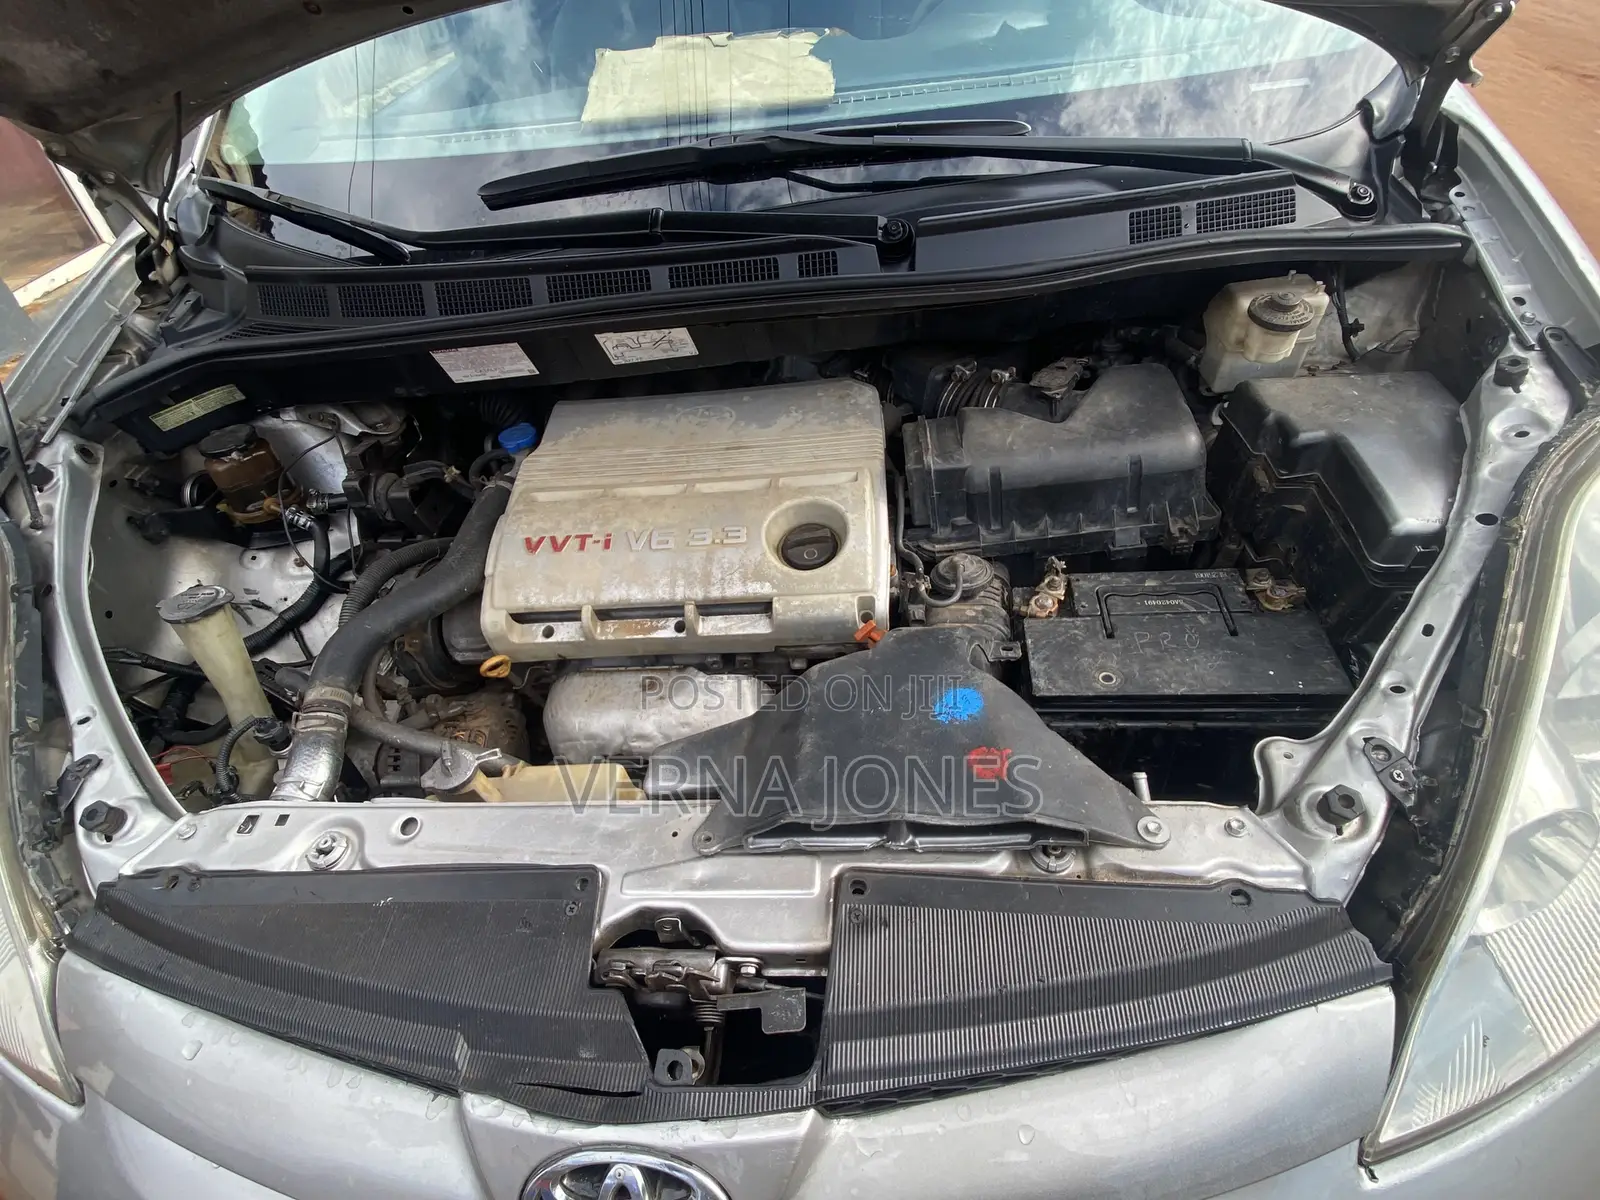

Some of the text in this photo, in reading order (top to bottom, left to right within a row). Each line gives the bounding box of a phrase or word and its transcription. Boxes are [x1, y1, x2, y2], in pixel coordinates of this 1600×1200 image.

[524, 526, 747, 556] VVT-i V6 3.3
